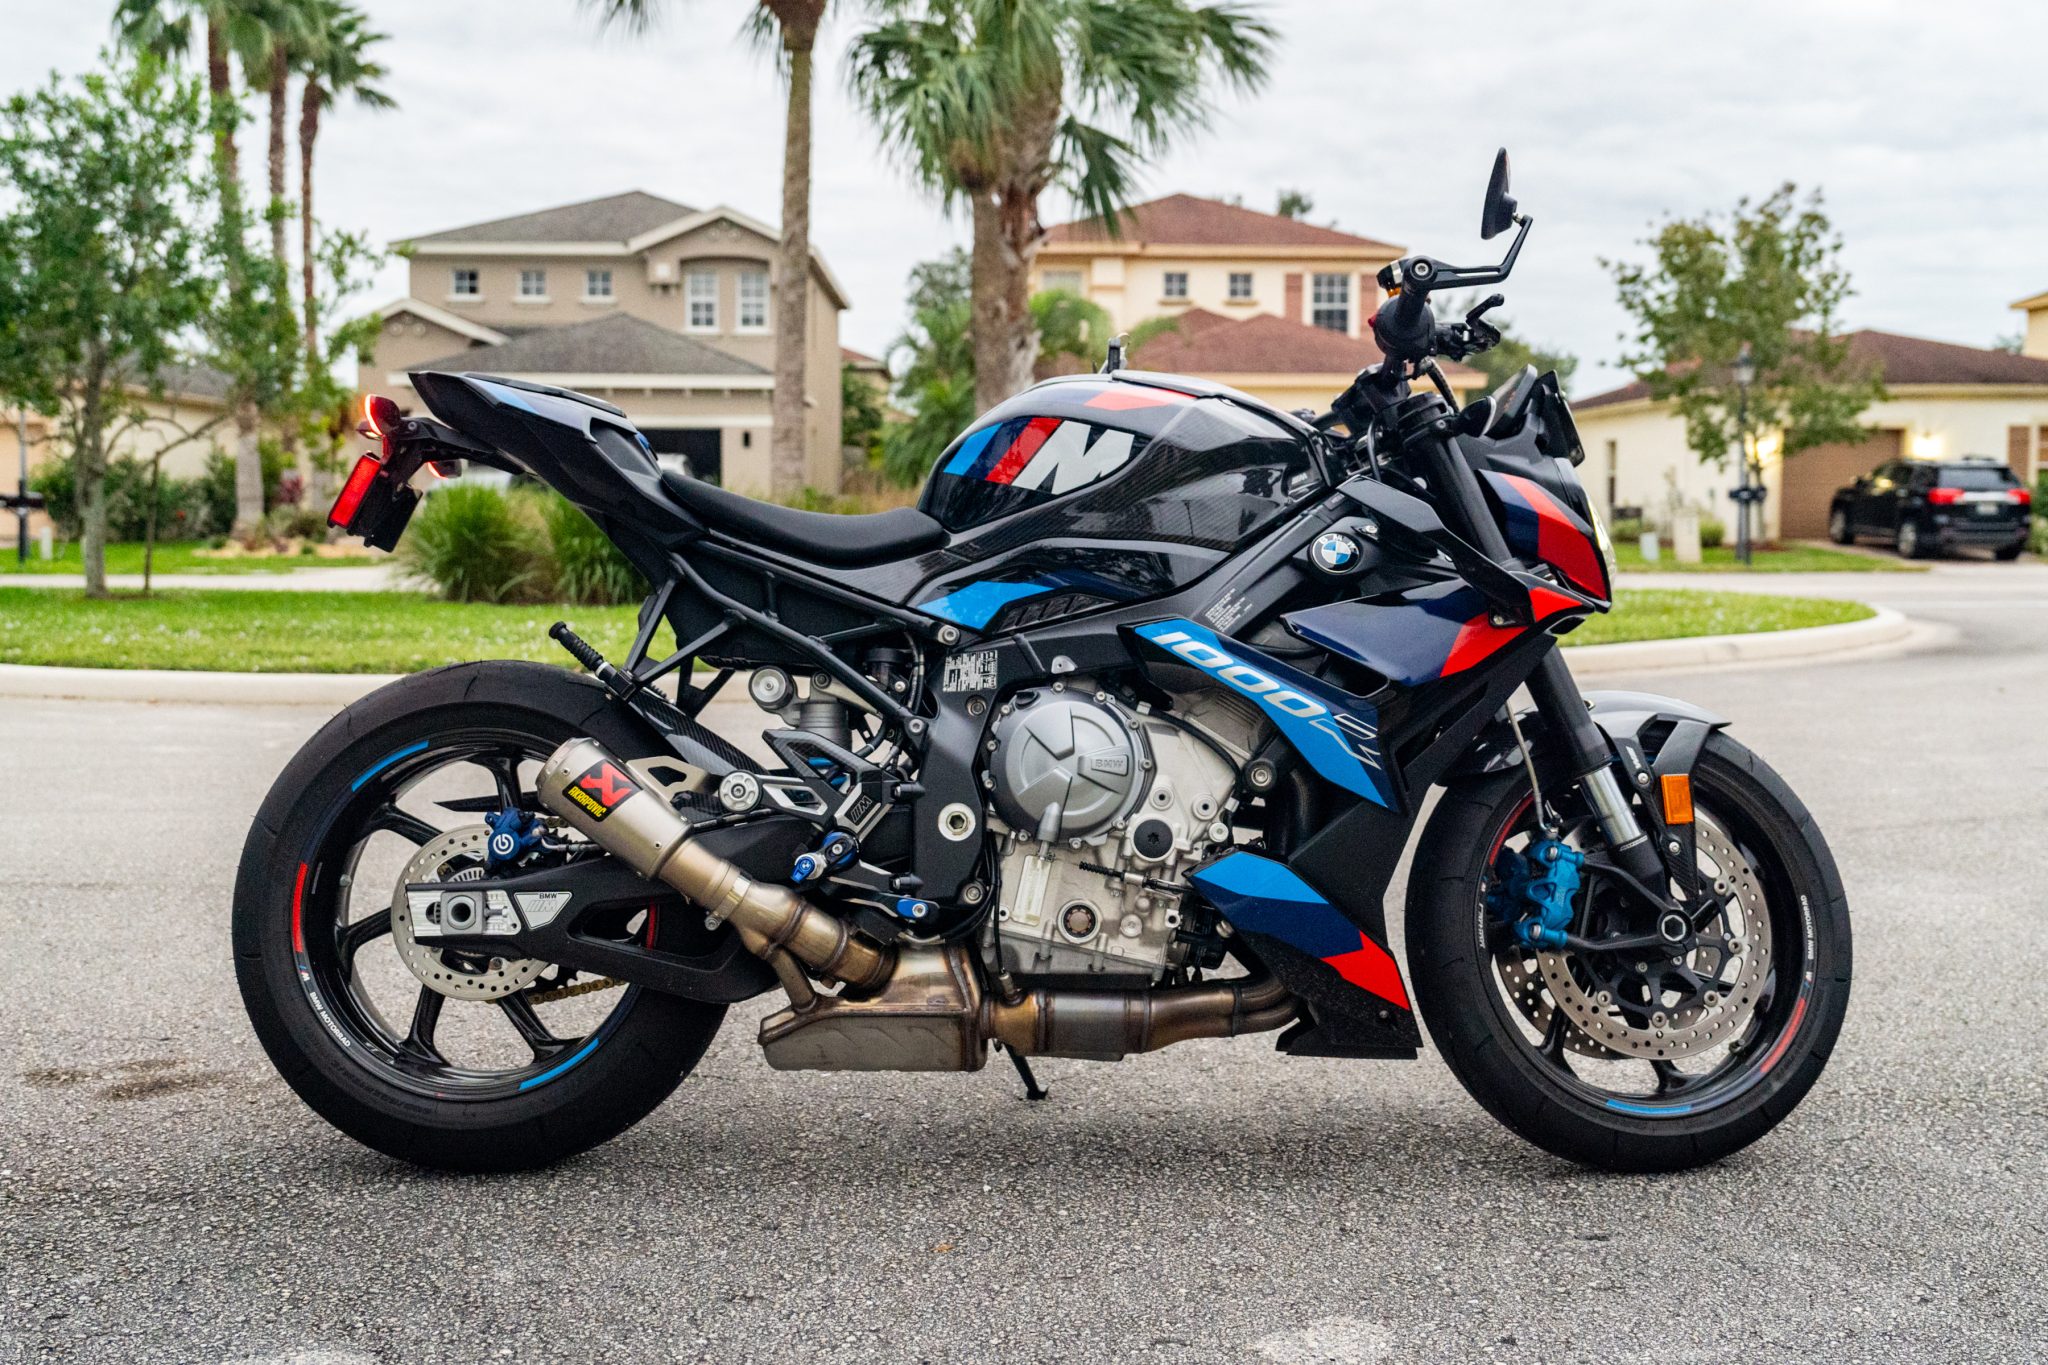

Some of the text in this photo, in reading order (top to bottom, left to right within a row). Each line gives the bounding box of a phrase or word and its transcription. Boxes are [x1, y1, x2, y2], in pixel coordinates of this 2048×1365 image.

[1010, 419, 1135, 496] M
[1095, 759, 1124, 768] BMW
[1800, 894, 1814, 939] MOTORRAD
[310, 992, 323, 1011] BMW
[320, 1011, 351, 1047] MOTORRAD
